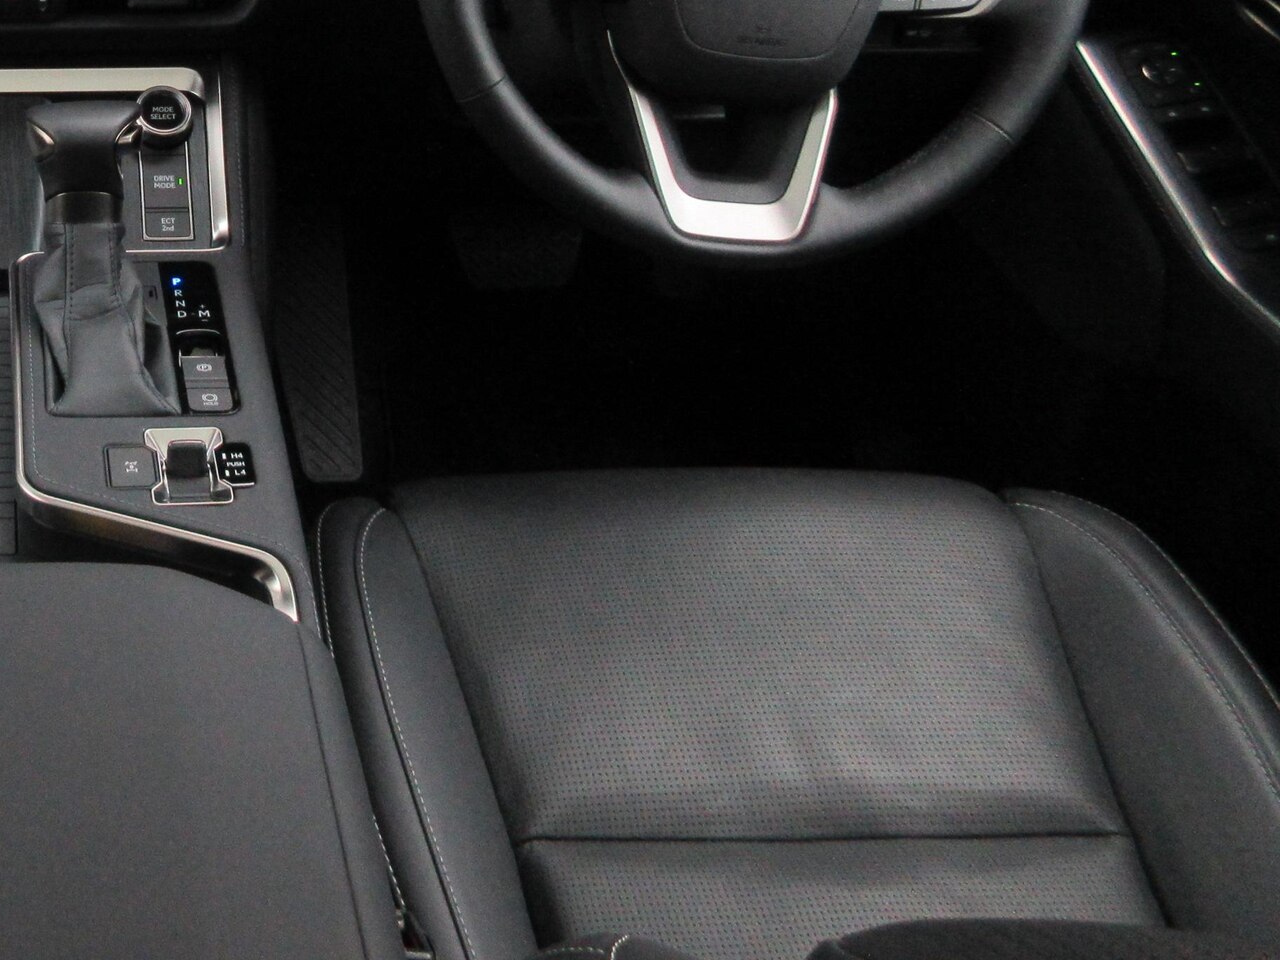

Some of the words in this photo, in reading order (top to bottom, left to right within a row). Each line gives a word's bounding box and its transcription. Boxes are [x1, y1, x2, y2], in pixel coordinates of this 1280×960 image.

[172, 277, 182, 286] P
[174, 289, 183, 297] R
[177, 310, 187, 318] D
[198, 309, 211, 318] M
[230, 452, 244, 460] H4
[226, 460, 246, 468] PUSH
